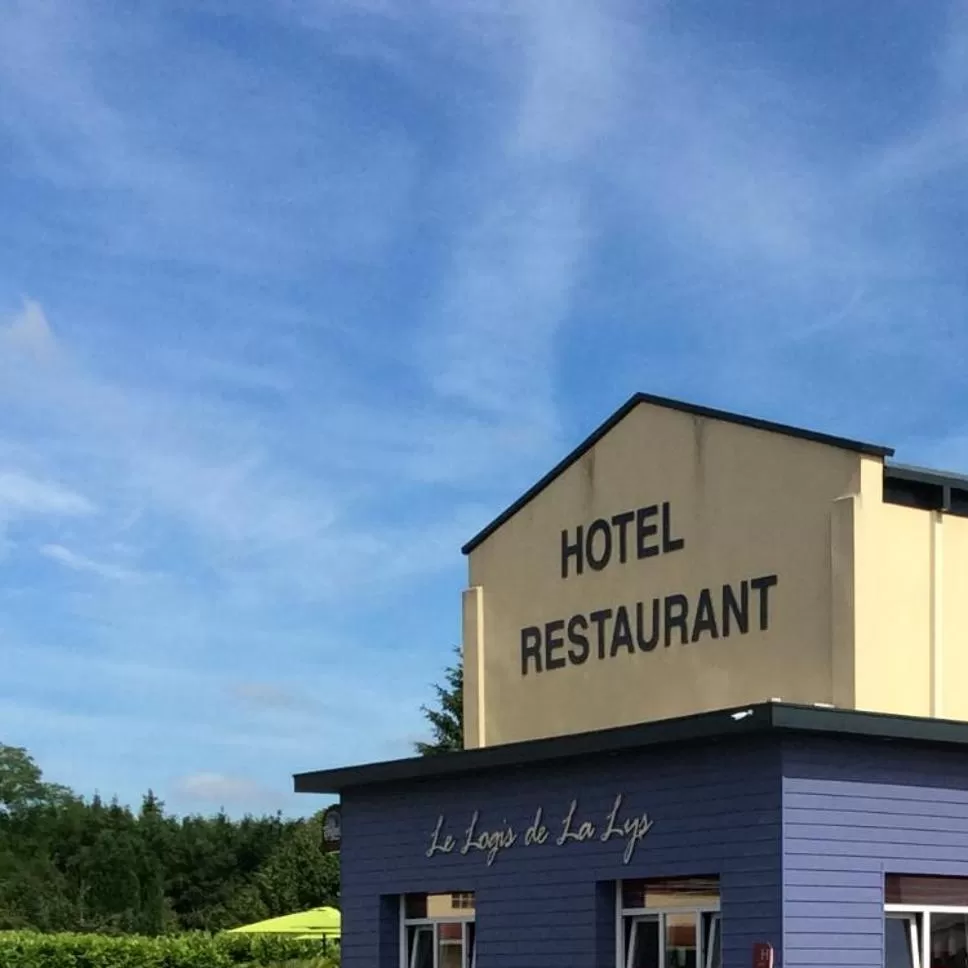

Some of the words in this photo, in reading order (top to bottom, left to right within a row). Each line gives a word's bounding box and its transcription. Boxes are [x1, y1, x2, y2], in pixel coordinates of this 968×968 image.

[561, 501, 685, 579] HOTEL
[520, 574, 778, 676] RESTAURANT
[426, 814, 455, 858] Le
[460, 810, 517, 867] Logis
[525, 807, 548, 846] de
[556, 799, 595, 846] La
[601, 793, 653, 864] Lys
